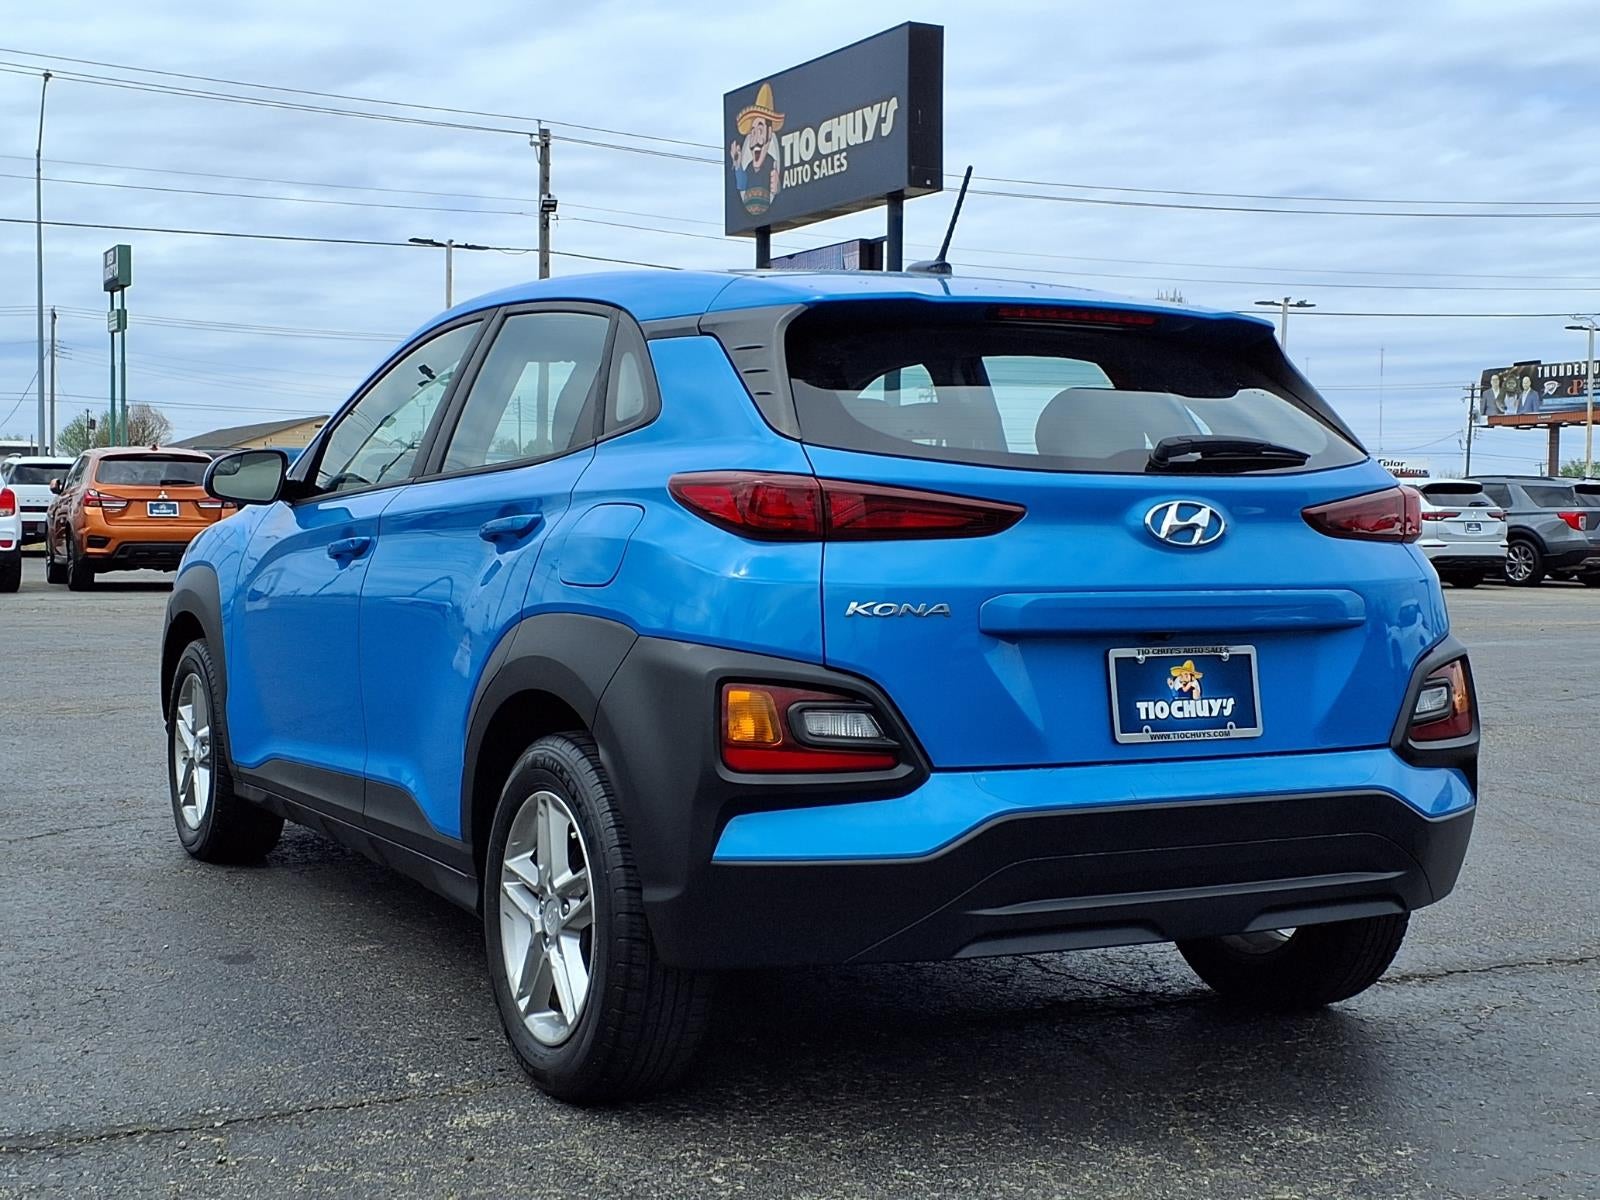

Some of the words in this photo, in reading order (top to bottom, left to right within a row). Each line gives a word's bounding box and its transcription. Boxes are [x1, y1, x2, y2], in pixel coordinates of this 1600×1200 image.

[781, 127, 816, 168] TIO
[817, 97, 898, 155] CHUY'S
[782, 164, 811, 189] AUTO
[813, 152, 848, 180] SALES
[1537, 363, 1587, 378] THUNDER
[845, 601, 951, 617] KONA
[1136, 648, 1150, 656] TIO
[1151, 647, 1181, 655] CHUY'S
[1204, 646, 1229, 654] SALES
[1136, 700, 1170, 720] TIO
[1170, 697, 1235, 719] CHUY'S
[1149, 730, 1231, 741] WWW.TIOCHUYS.COM
